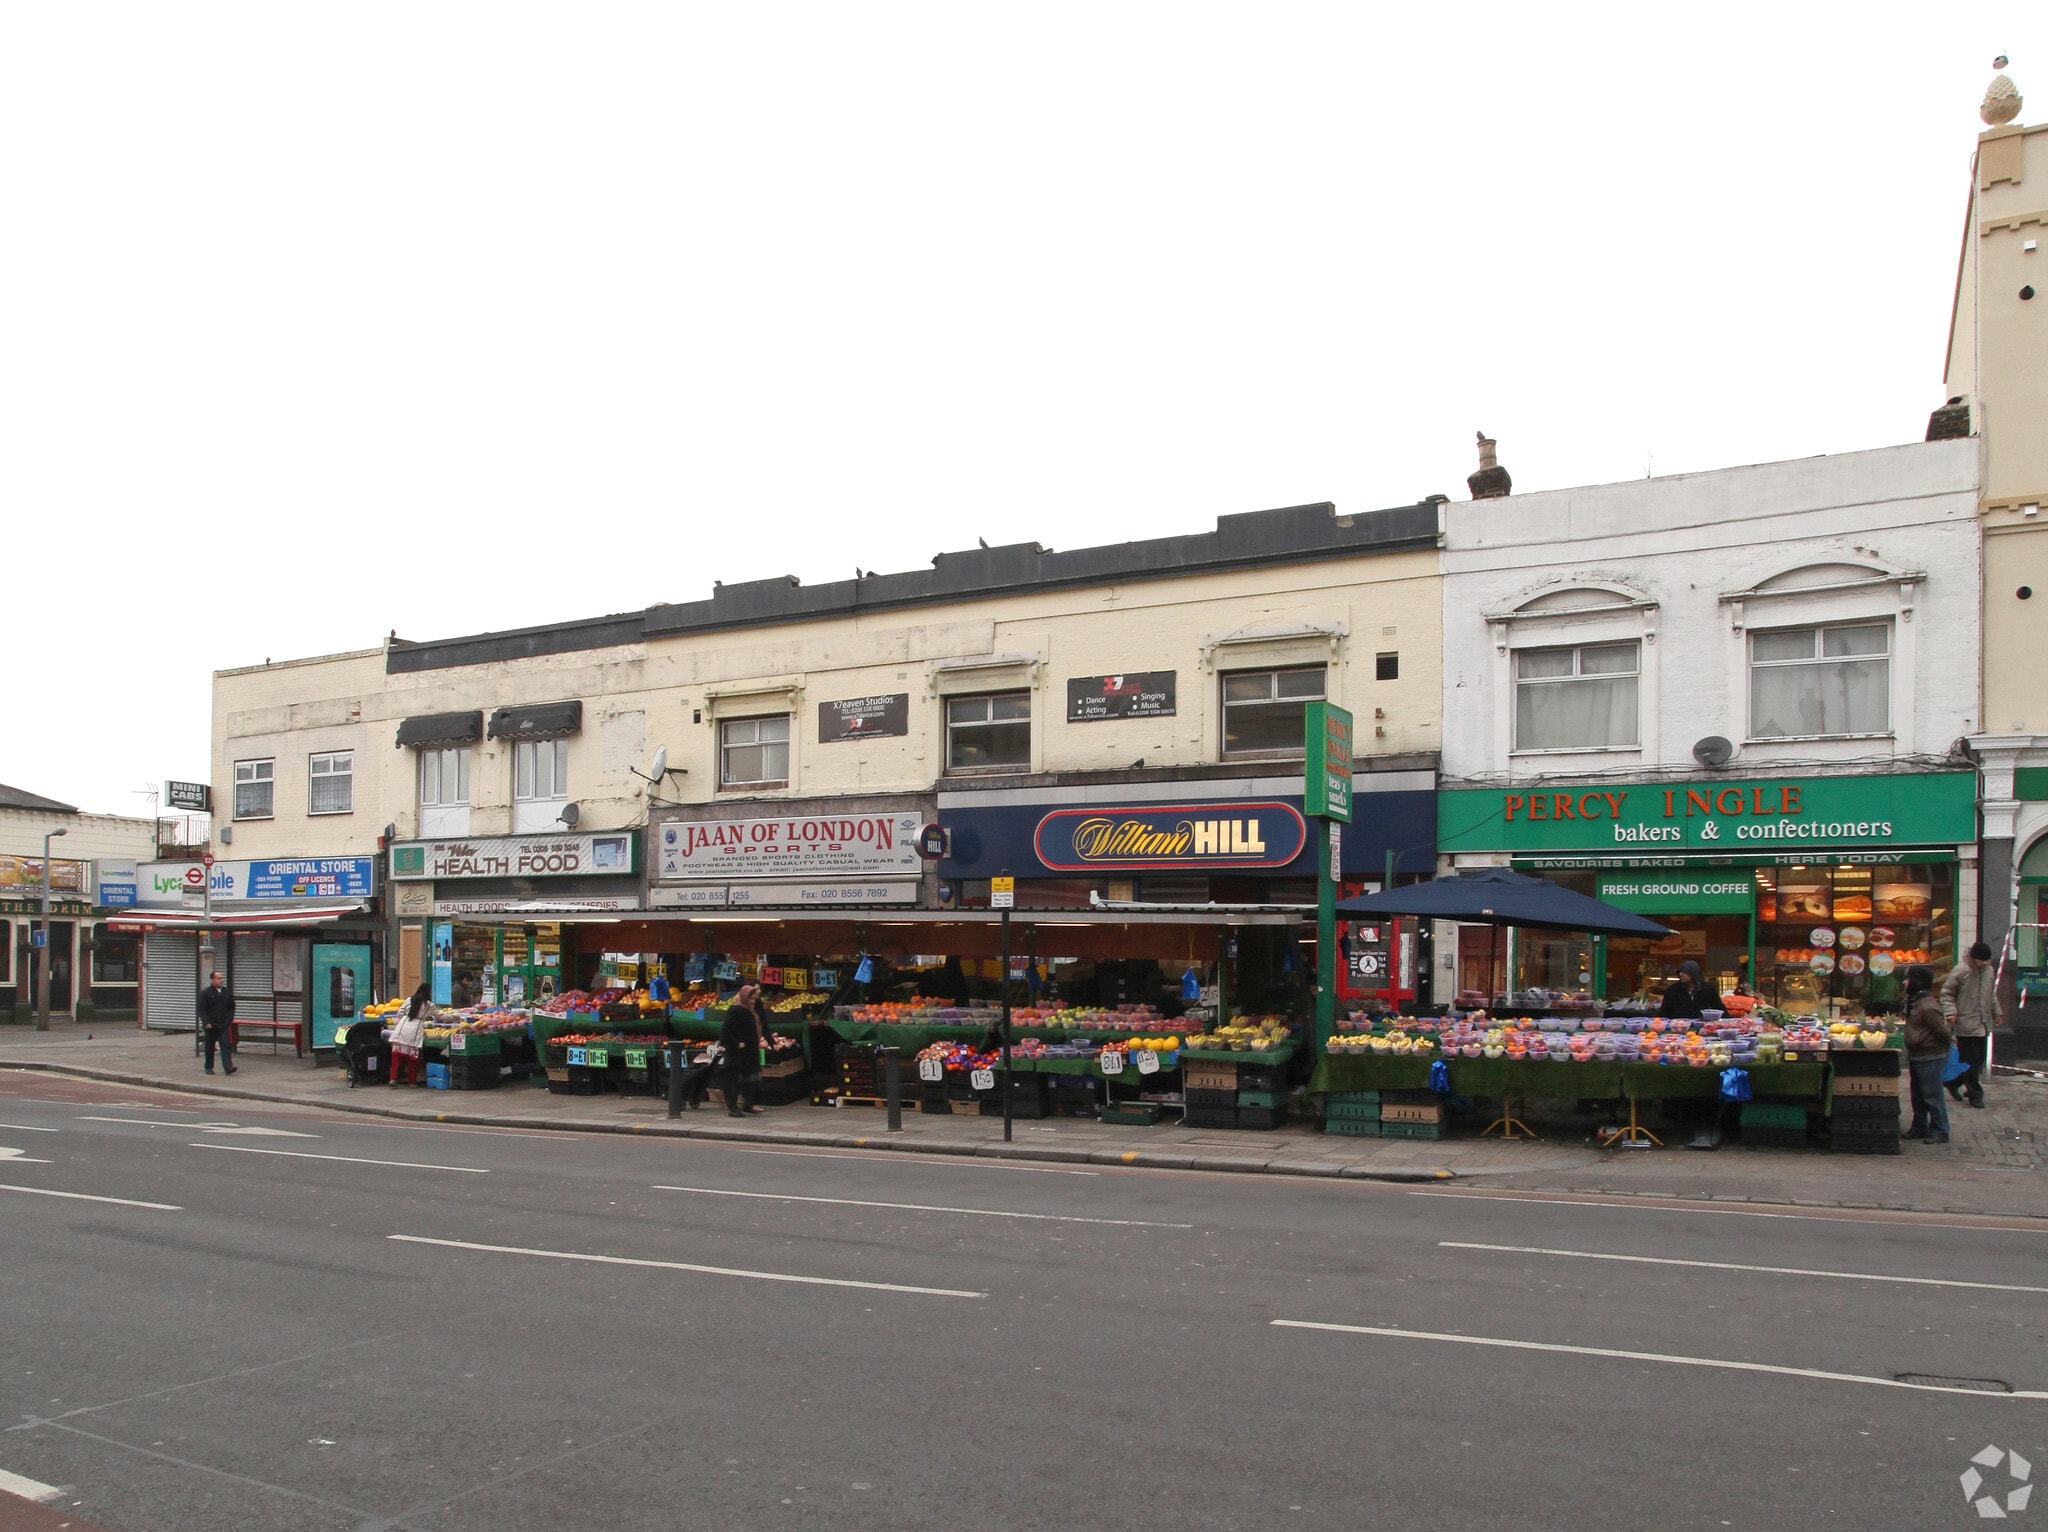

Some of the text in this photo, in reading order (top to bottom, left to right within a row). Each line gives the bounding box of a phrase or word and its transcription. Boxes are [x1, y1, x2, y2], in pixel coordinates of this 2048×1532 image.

[866, 696, 894, 706] Studios
[1141, 693, 1166, 701] Singing
[1086, 706, 1106, 714] Acting
[1327, 716, 1351, 743] PERCY
[1327, 739, 1350, 763] INGLE
[172, 782, 200, 792] MINI
[1328, 775, 1340, 791] teas
[171, 790, 202, 800] CABS
[1328, 791, 1347, 806] snacks
[1503, 786, 1803, 820] PERCY INGLE
[1614, 820, 1893, 842] bakers & confectioners
[682, 818, 894, 857] JAAN OF LONDON
[1072, 817, 1266, 858] William HILL
[724, 844, 842, 854] SPORTS
[927, 840, 942, 852] HILL
[434, 857, 510, 876] HEALTH
[518, 854, 580, 873] FOOD
[1534, 858, 1685, 869] SAVOURIES BAKED
[1775, 854, 1905, 865] HERE TODAY
[269, 860, 356, 874] ORIENTAL STORE
[102, 887, 135, 895] ORIENTAL
[802, 888, 888, 898] Fax: 020 8556 7892
[1602, 882, 1749, 896] FRESH GROUND COFFEE
[676, 892, 688, 900] Tel:
[691, 892, 706, 900] 020
[732, 891, 750, 900] 1255
[2, 902, 92, 914] THE DRUM
[440, 902, 472, 912] HEALTH
[786, 972, 806, 985] 6 £1
[815, 973, 836, 984] 8 £1
[568, 1050, 586, 1062] 8 £1
[590, 1052, 607, 1064] 10 £1
[626, 1053, 646, 1066] 10 £1
